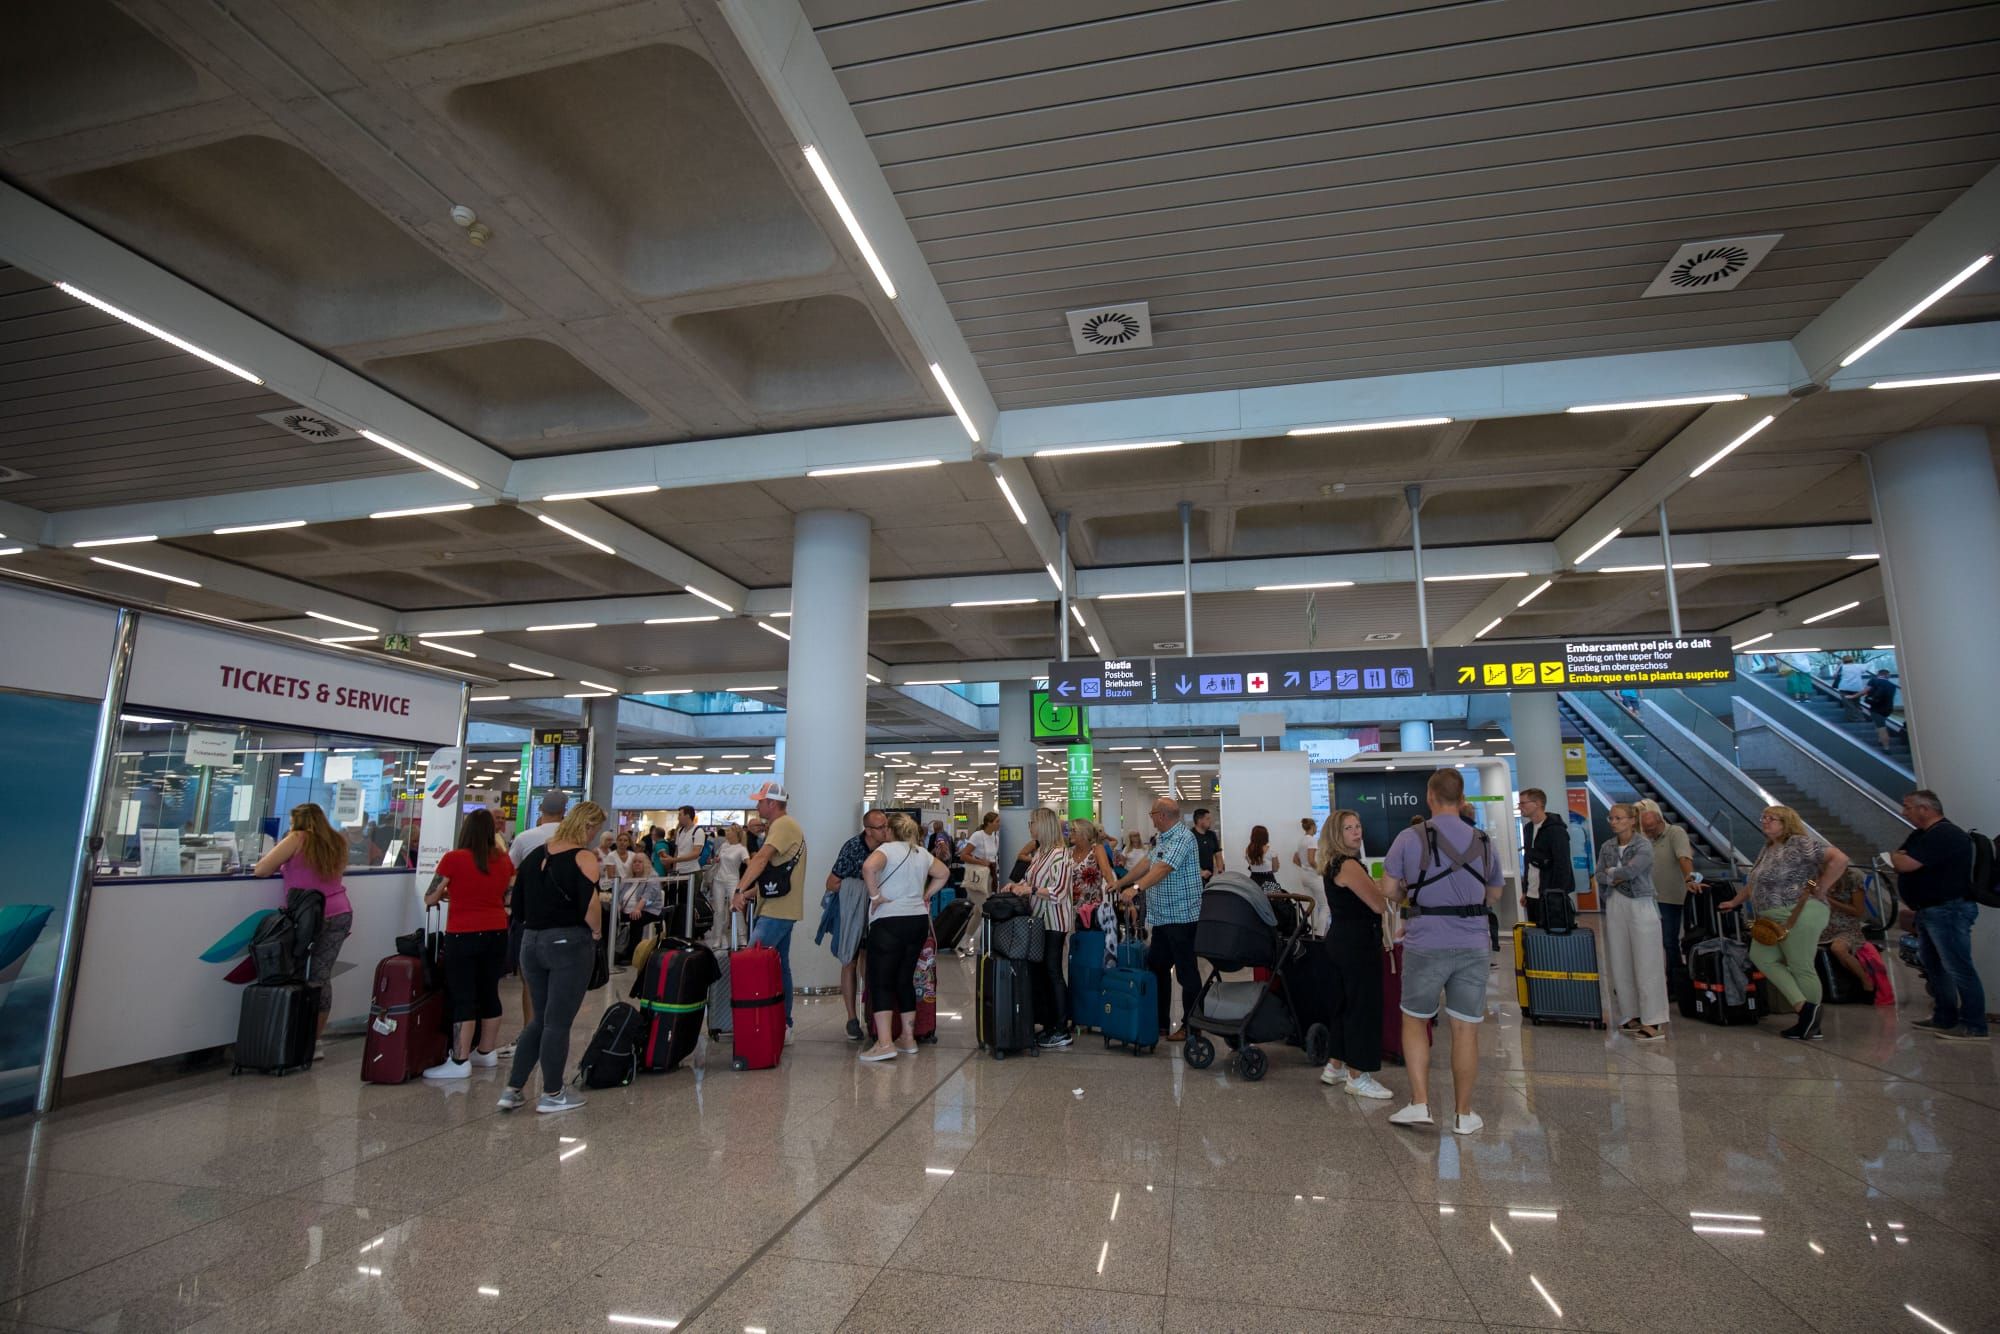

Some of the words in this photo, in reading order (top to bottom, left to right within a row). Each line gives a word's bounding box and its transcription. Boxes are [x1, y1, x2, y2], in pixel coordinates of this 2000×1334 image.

[1566, 642, 1639, 653] Embarcament
[1640, 641, 1657, 651] pel
[1658, 640, 1673, 651] pis
[1675, 640, 1688, 649] de
[1690, 639, 1711, 649] dalt
[1567, 654, 1602, 663] Boarding
[1615, 653, 1628, 661] the
[1629, 653, 1652, 663] upper
[1653, 652, 1672, 660] floor
[1104, 661, 1132, 670] Bústia
[1568, 664, 1600, 673] Einstieg
[1612, 662, 1668, 672] obergeschoss
[1105, 671, 1134, 679] Post-box
[1569, 673, 1621, 684] Embarque
[1624, 673, 1637, 682] en
[1638, 672, 1649, 681] la
[1650, 671, 1684, 683] planta
[1685, 670, 1730, 681] superior
[1105, 680, 1143, 688] Briefkasten
[220, 665, 310, 700] TICKETS
[316, 684, 330, 703] &
[335, 687, 410, 716] SERVICE
[1105, 688, 1132, 697] Buzón
[1069, 757, 1089, 775] 11
[614, 784, 675, 796] COFFEE
[678, 783, 690, 796] &
[696, 783, 762, 796] BAKERY
[1389, 792, 1418, 805] info
